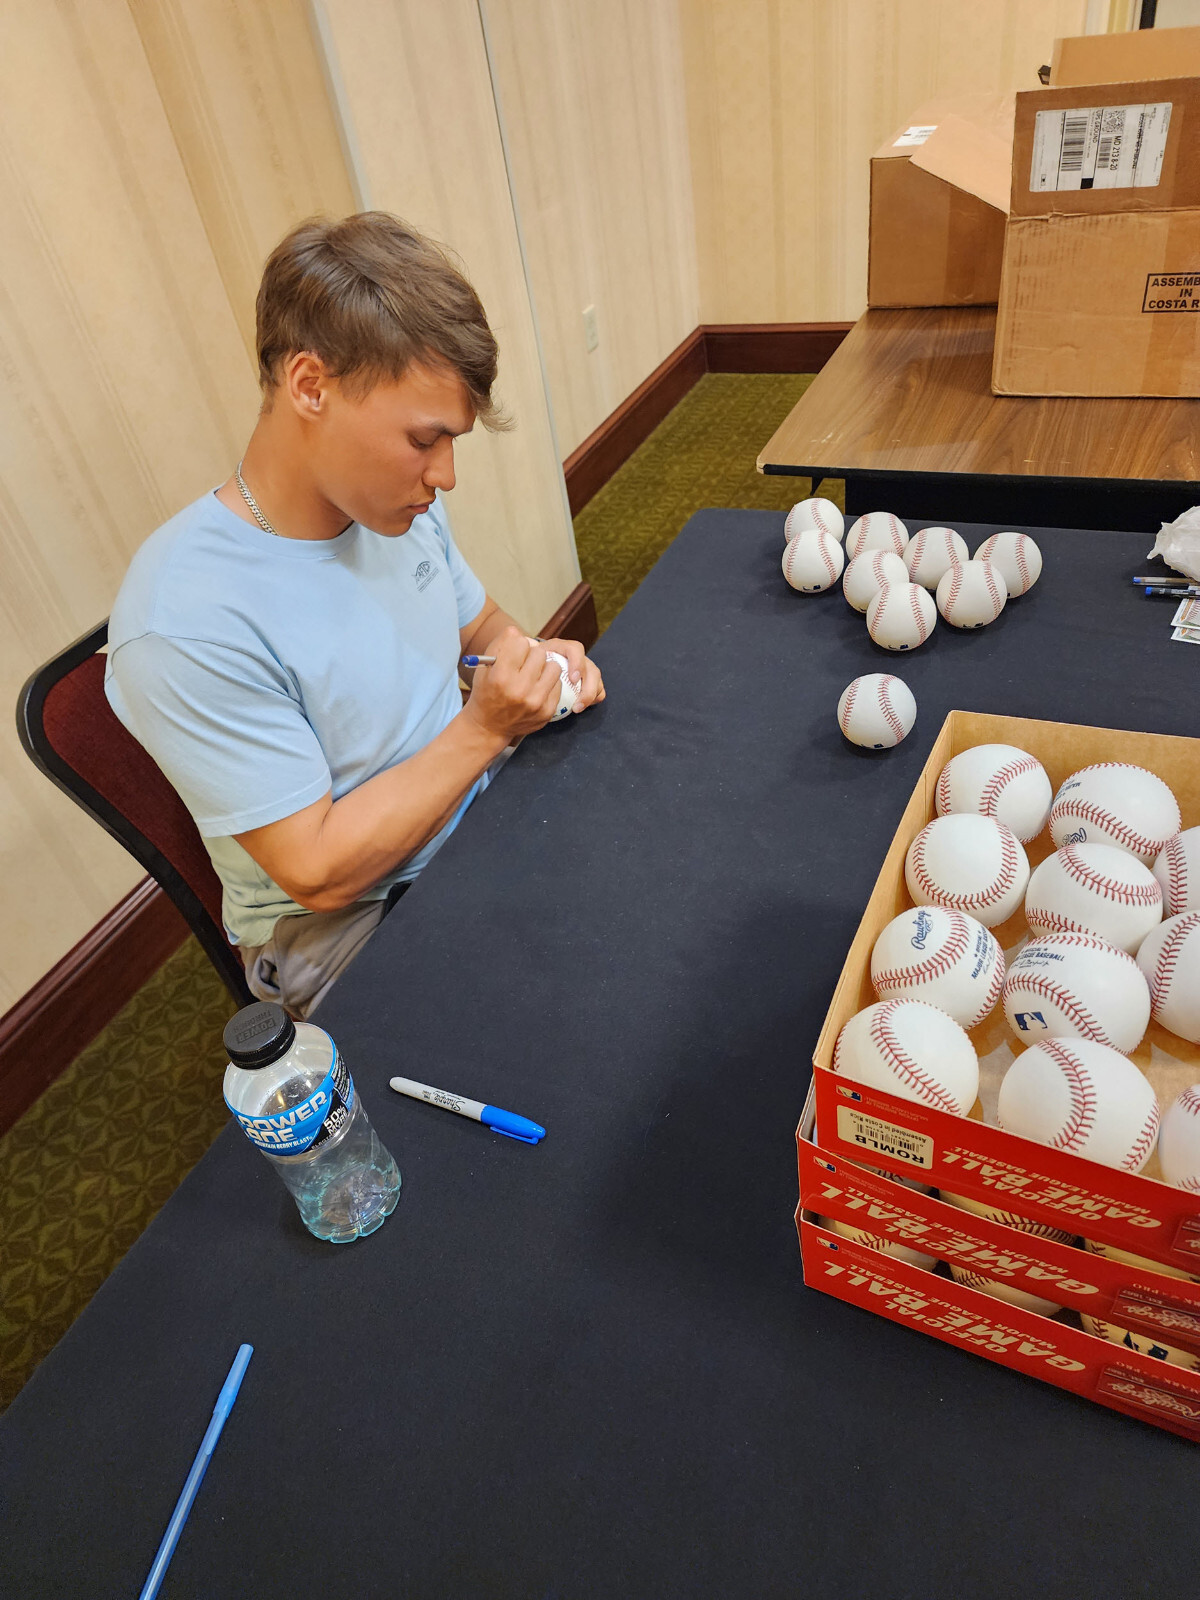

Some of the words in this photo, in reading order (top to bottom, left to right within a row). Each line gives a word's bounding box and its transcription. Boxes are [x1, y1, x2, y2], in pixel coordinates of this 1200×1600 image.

[1092, 120, 1100, 144] GROUND
[1115, 136, 1122, 144] MD
[1148, 300, 1187, 308] COSTA
[1180, 288, 1193, 298] IN
[972, 959, 984, 979] MAJOR
[1036, 952, 1064, 962] BASEBALL
[238, 1091, 328, 1132] POWER
[324, 1106, 345, 1130] 50%
[865, 1118, 883, 1129] Costa
[854, 1134, 924, 1164] ROMLB
[891, 1128, 926, 1144] Assembled
[942, 1150, 1034, 1188] BALL
[954, 1147, 1027, 1174] BASEBALL
[1030, 1172, 1089, 1194] LEAGUE
[820, 1182, 932, 1235] BALL
[848, 1186, 928, 1222] BASEBALL
[982, 1176, 1102, 1220] OFFICIAL
[1037, 1186, 1162, 1228] GAME
[1091, 1194, 1151, 1214] MAJOR
[884, 1223, 1015, 1276] OFFICIAL
[930, 1222, 998, 1250] LEAGUE
[937, 1237, 1100, 1294] GAME
[1000, 1249, 1068, 1274] MAJOR
[824, 1260, 931, 1311] BALL
[850, 1264, 926, 1298] BASEBALL
[928, 1297, 992, 1324] LEAGUE
[884, 1300, 1008, 1352] OFFICIAL
[994, 1324, 1057, 1350] MAJOR
[936, 1312, 1086, 1372] GAME
